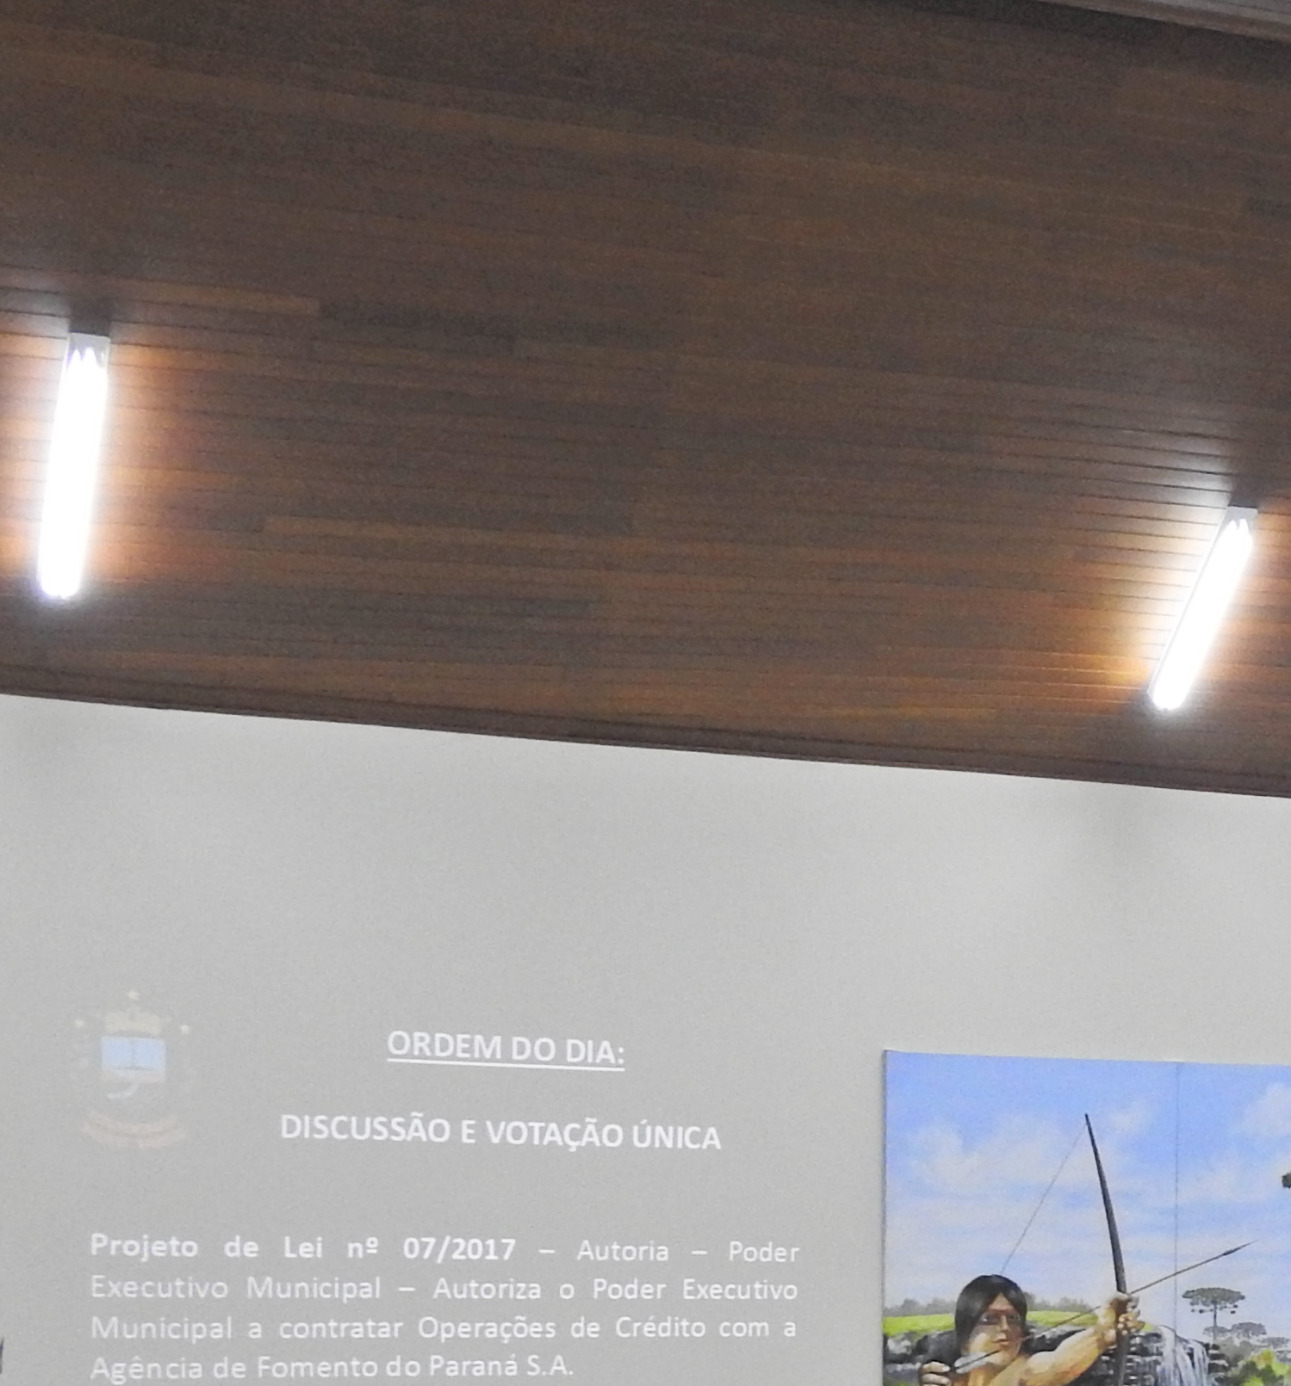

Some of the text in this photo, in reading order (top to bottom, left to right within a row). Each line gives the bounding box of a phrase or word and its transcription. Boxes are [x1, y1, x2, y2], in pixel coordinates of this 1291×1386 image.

[386, 1029, 626, 1064] ORDEM DO DIA:
[279, 1110, 723, 1153] DISCUSSÃO E VOTAÇÃO ÚNICA
[89, 1231, 200, 1263] Projeto
[223, 1234, 260, 1259] de
[283, 1235, 324, 1259] Lei
[402, 1235, 517, 1265] 07/2017
[575, 1239, 670, 1263] Autoria
[728, 1239, 801, 1263] Poder
[90, 1274, 229, 1299] Executivo
[246, 1275, 382, 1304] Municipal
[432, 1277, 542, 1300] Autoriza
[558, 1282, 576, 1300] o
[592, 1277, 667, 1300] Poder
[682, 1277, 799, 1300] Executivo
[90, 1314, 797, 1345] Municipal a contratar Operações de Crédito com a
[89, 1353, 574, 1386] Agência de Fomento do Paraná S.A.
